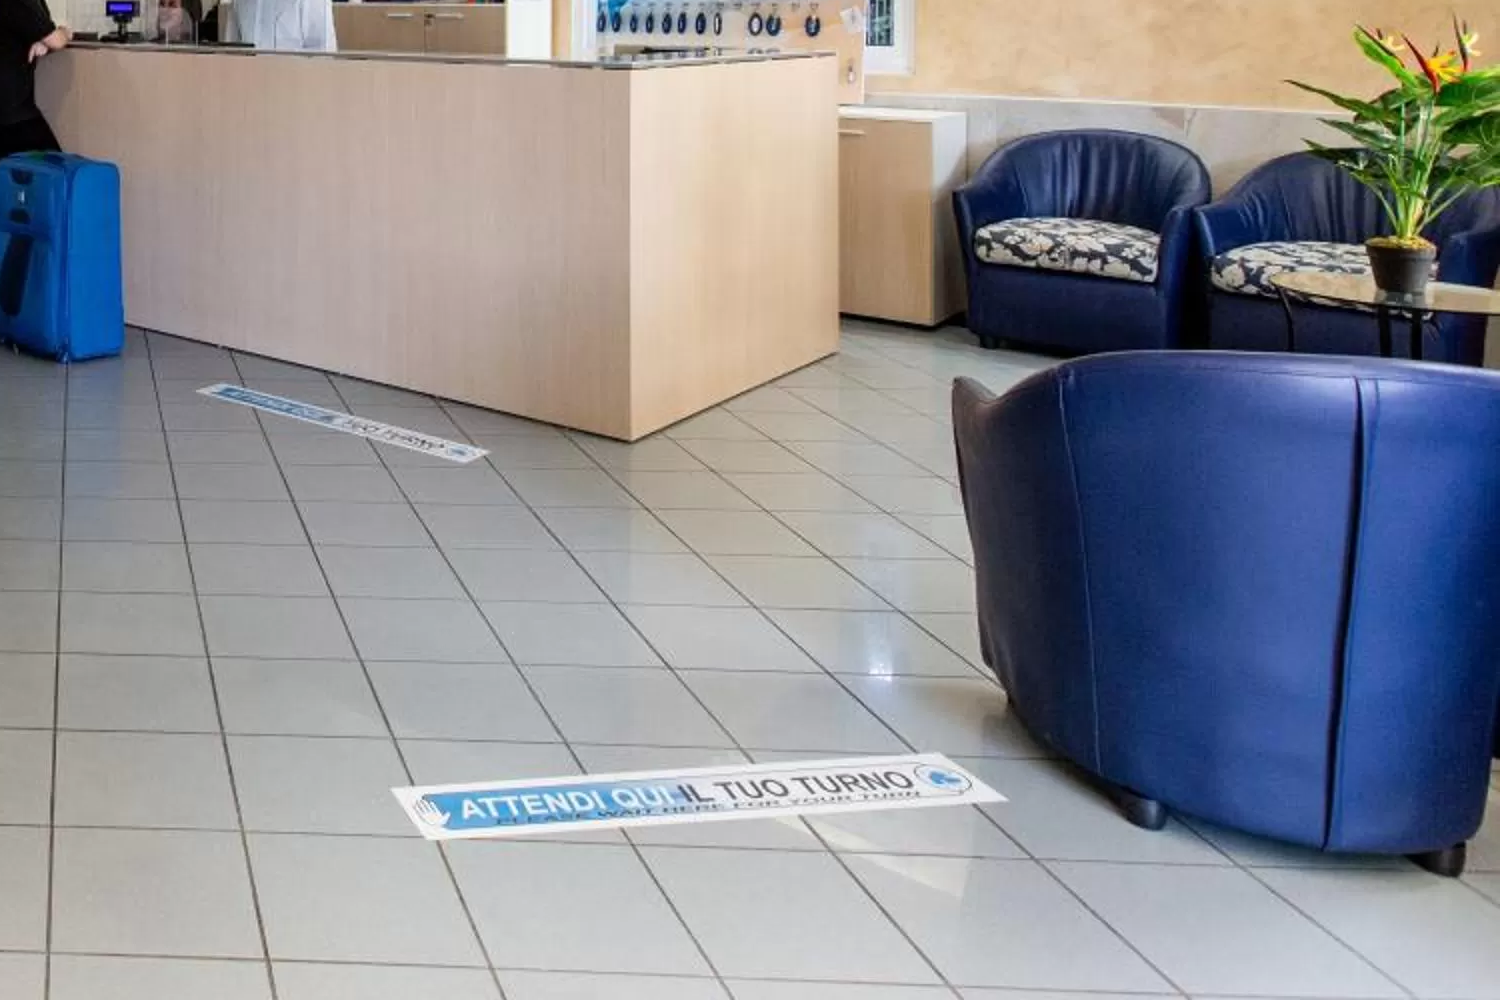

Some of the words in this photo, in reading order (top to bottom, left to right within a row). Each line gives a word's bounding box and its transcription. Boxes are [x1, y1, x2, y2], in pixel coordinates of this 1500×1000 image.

[462, 790, 607, 820] ATTENDI
[611, 784, 679, 806] QUI
[677, 783, 714, 802] IL
[713, 779, 789, 799] TUO
[791, 770, 914, 794] TURNO
